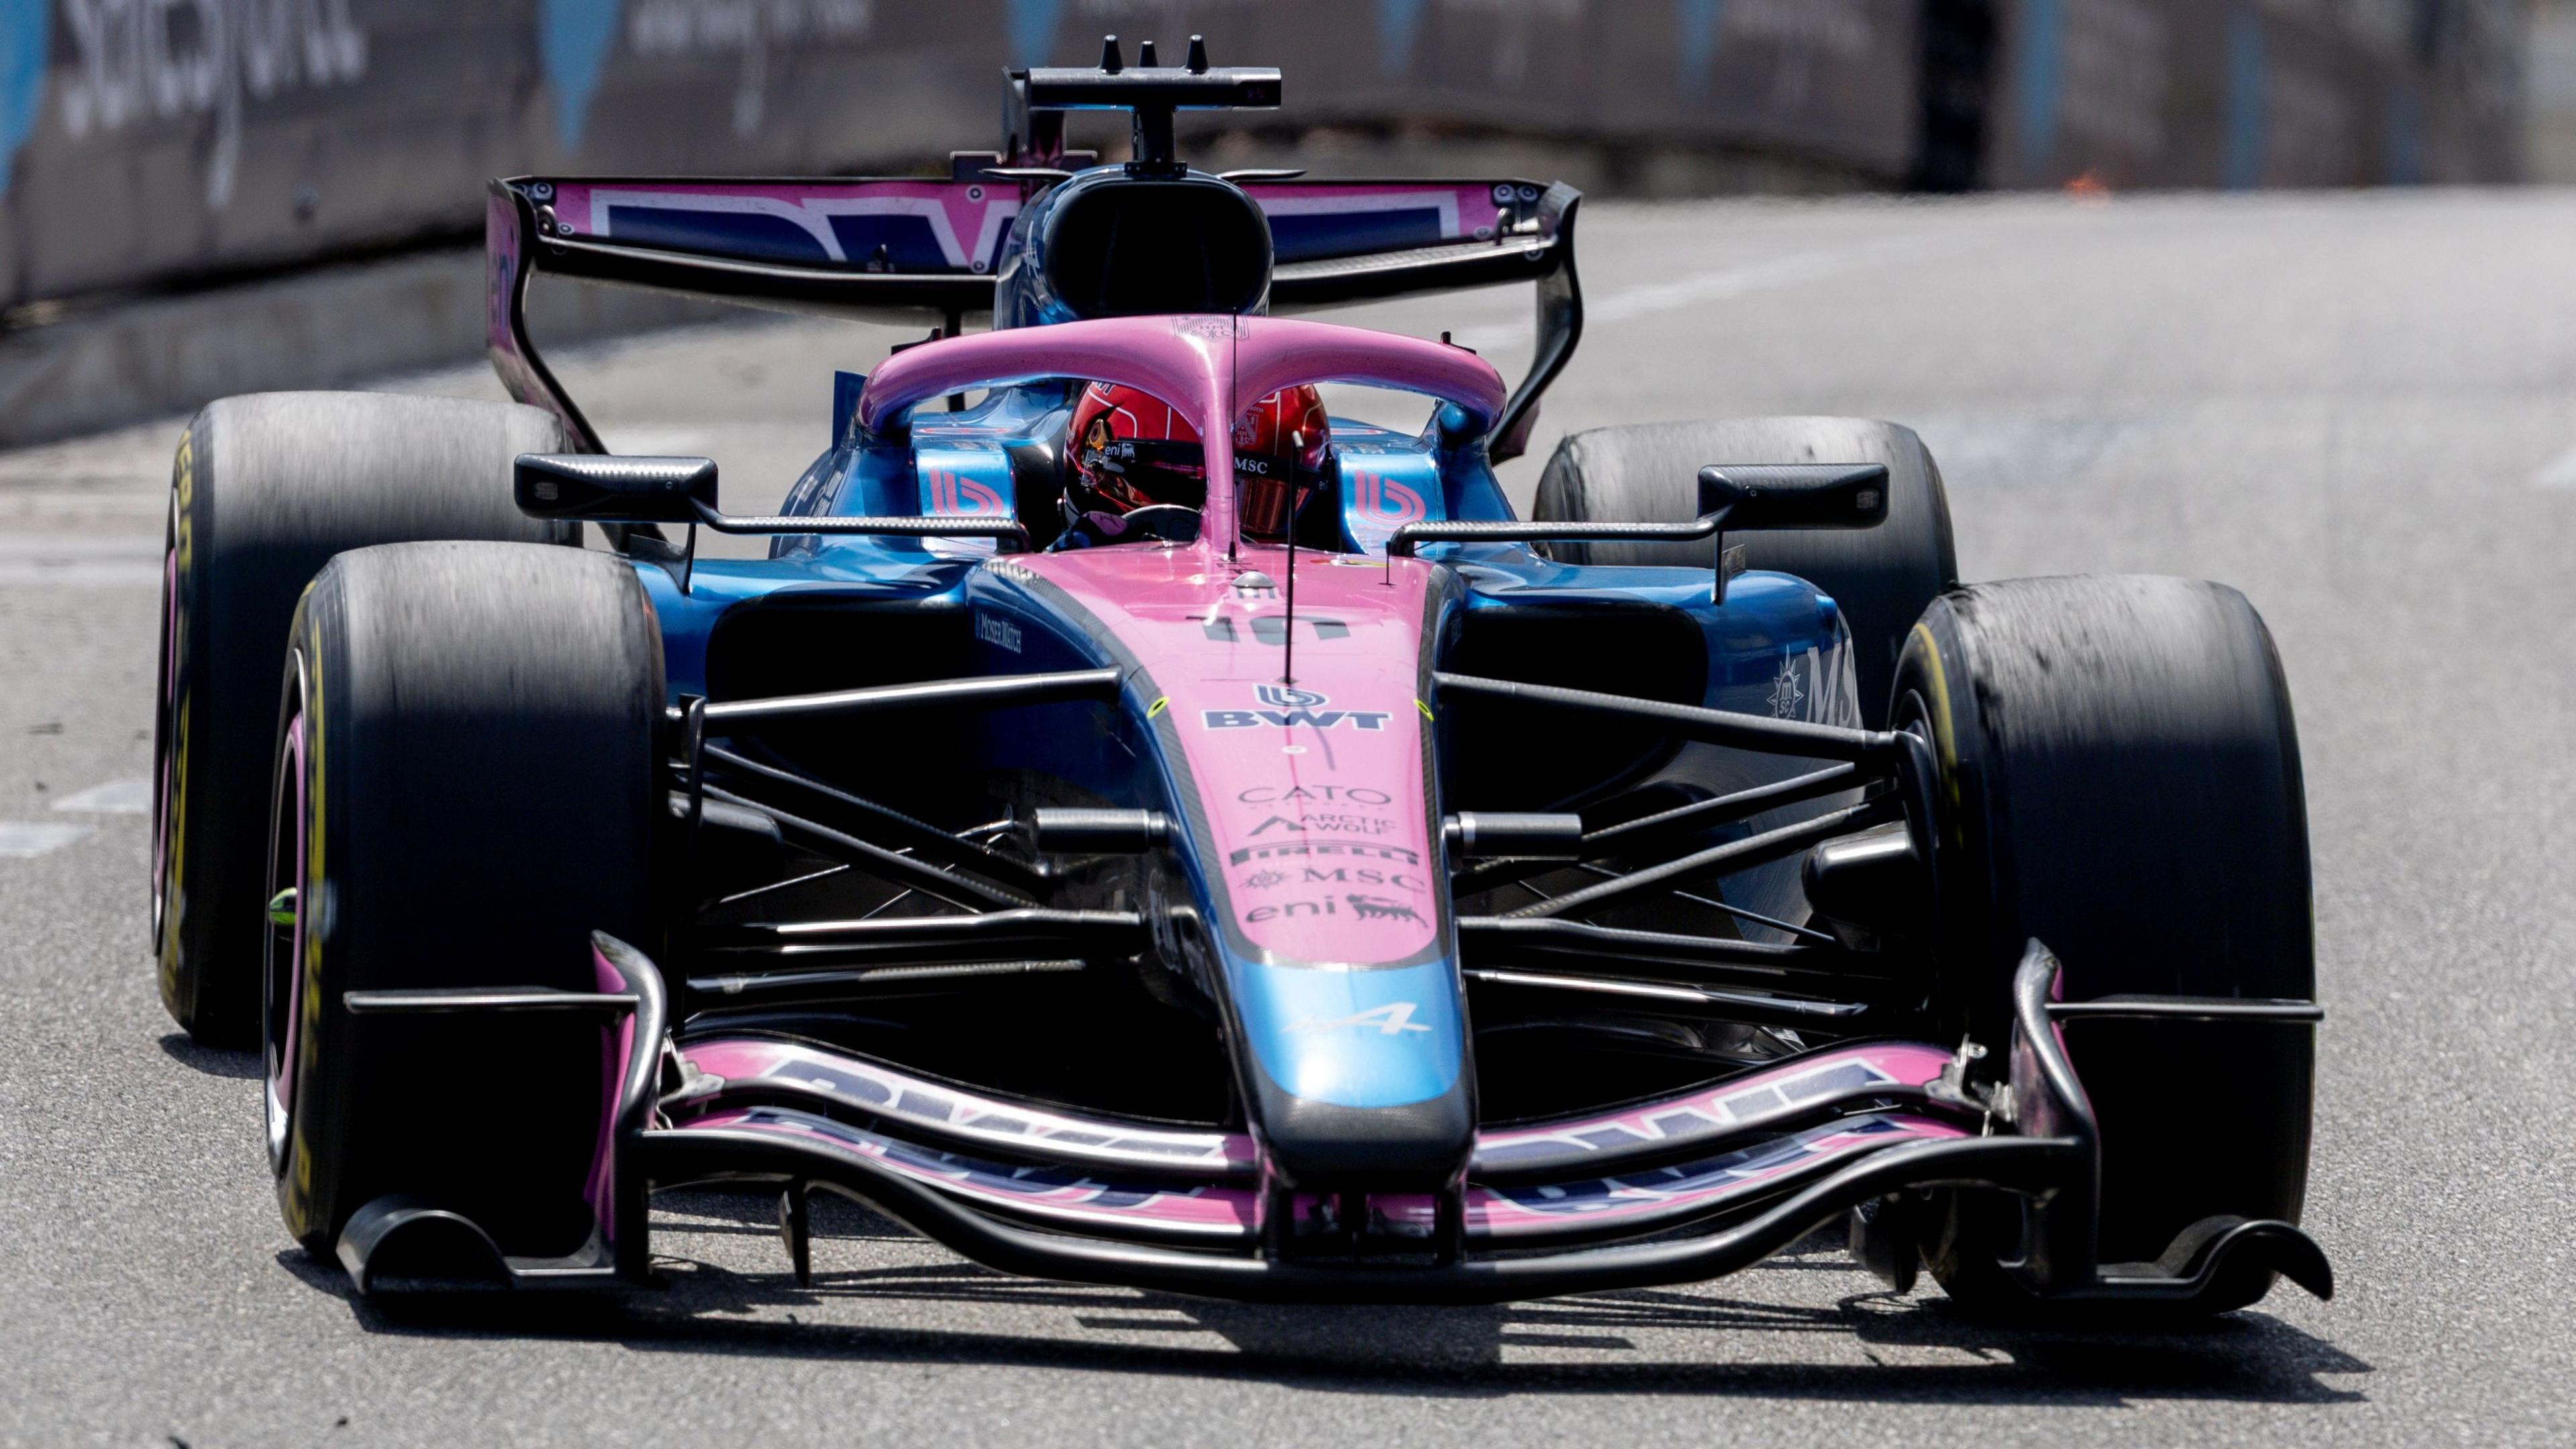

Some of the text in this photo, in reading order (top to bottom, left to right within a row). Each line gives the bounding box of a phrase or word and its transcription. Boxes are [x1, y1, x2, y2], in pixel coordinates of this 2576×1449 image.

[1105, 443, 1121, 456] eni
[1234, 457, 1267, 474] MSC
[1201, 709, 1393, 731] BWT
[1238, 786, 1392, 805] CATO
[1301, 814, 1397, 828] ARCTIC
[1315, 822, 1384, 835] WOLF
[1230, 839, 1419, 867] PIRELLI
[1301, 867, 1426, 894] MSC
[1245, 895, 1336, 923] eni
